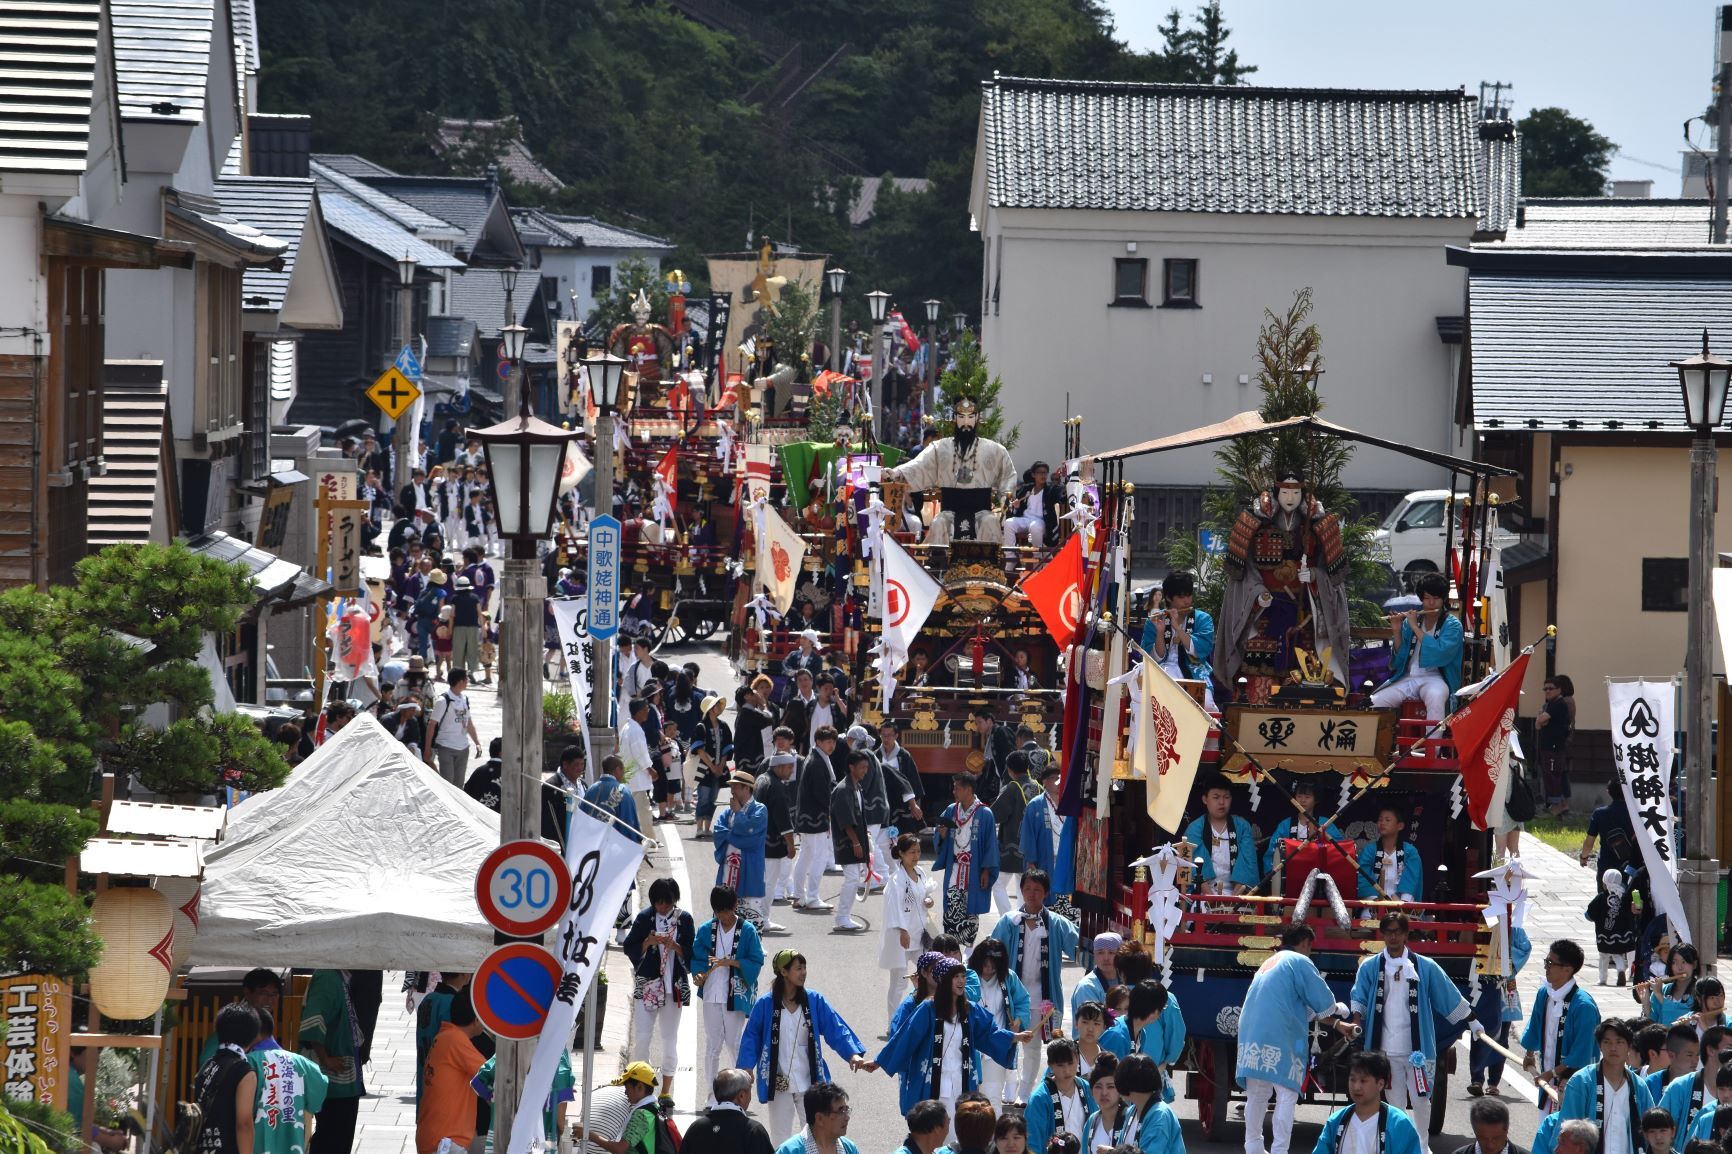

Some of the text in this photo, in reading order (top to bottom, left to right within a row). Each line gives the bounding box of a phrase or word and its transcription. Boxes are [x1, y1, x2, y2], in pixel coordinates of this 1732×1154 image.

[339, 515, 354, 581] ラーメン
[595, 531, 613, 626] 中歌姥神通
[499, 869, 550, 909] 30
[4, 985, 38, 1103] 工芸体験
[263, 1062, 280, 1129] 江差町
[280, 1055, 296, 1123] 北海道の里
